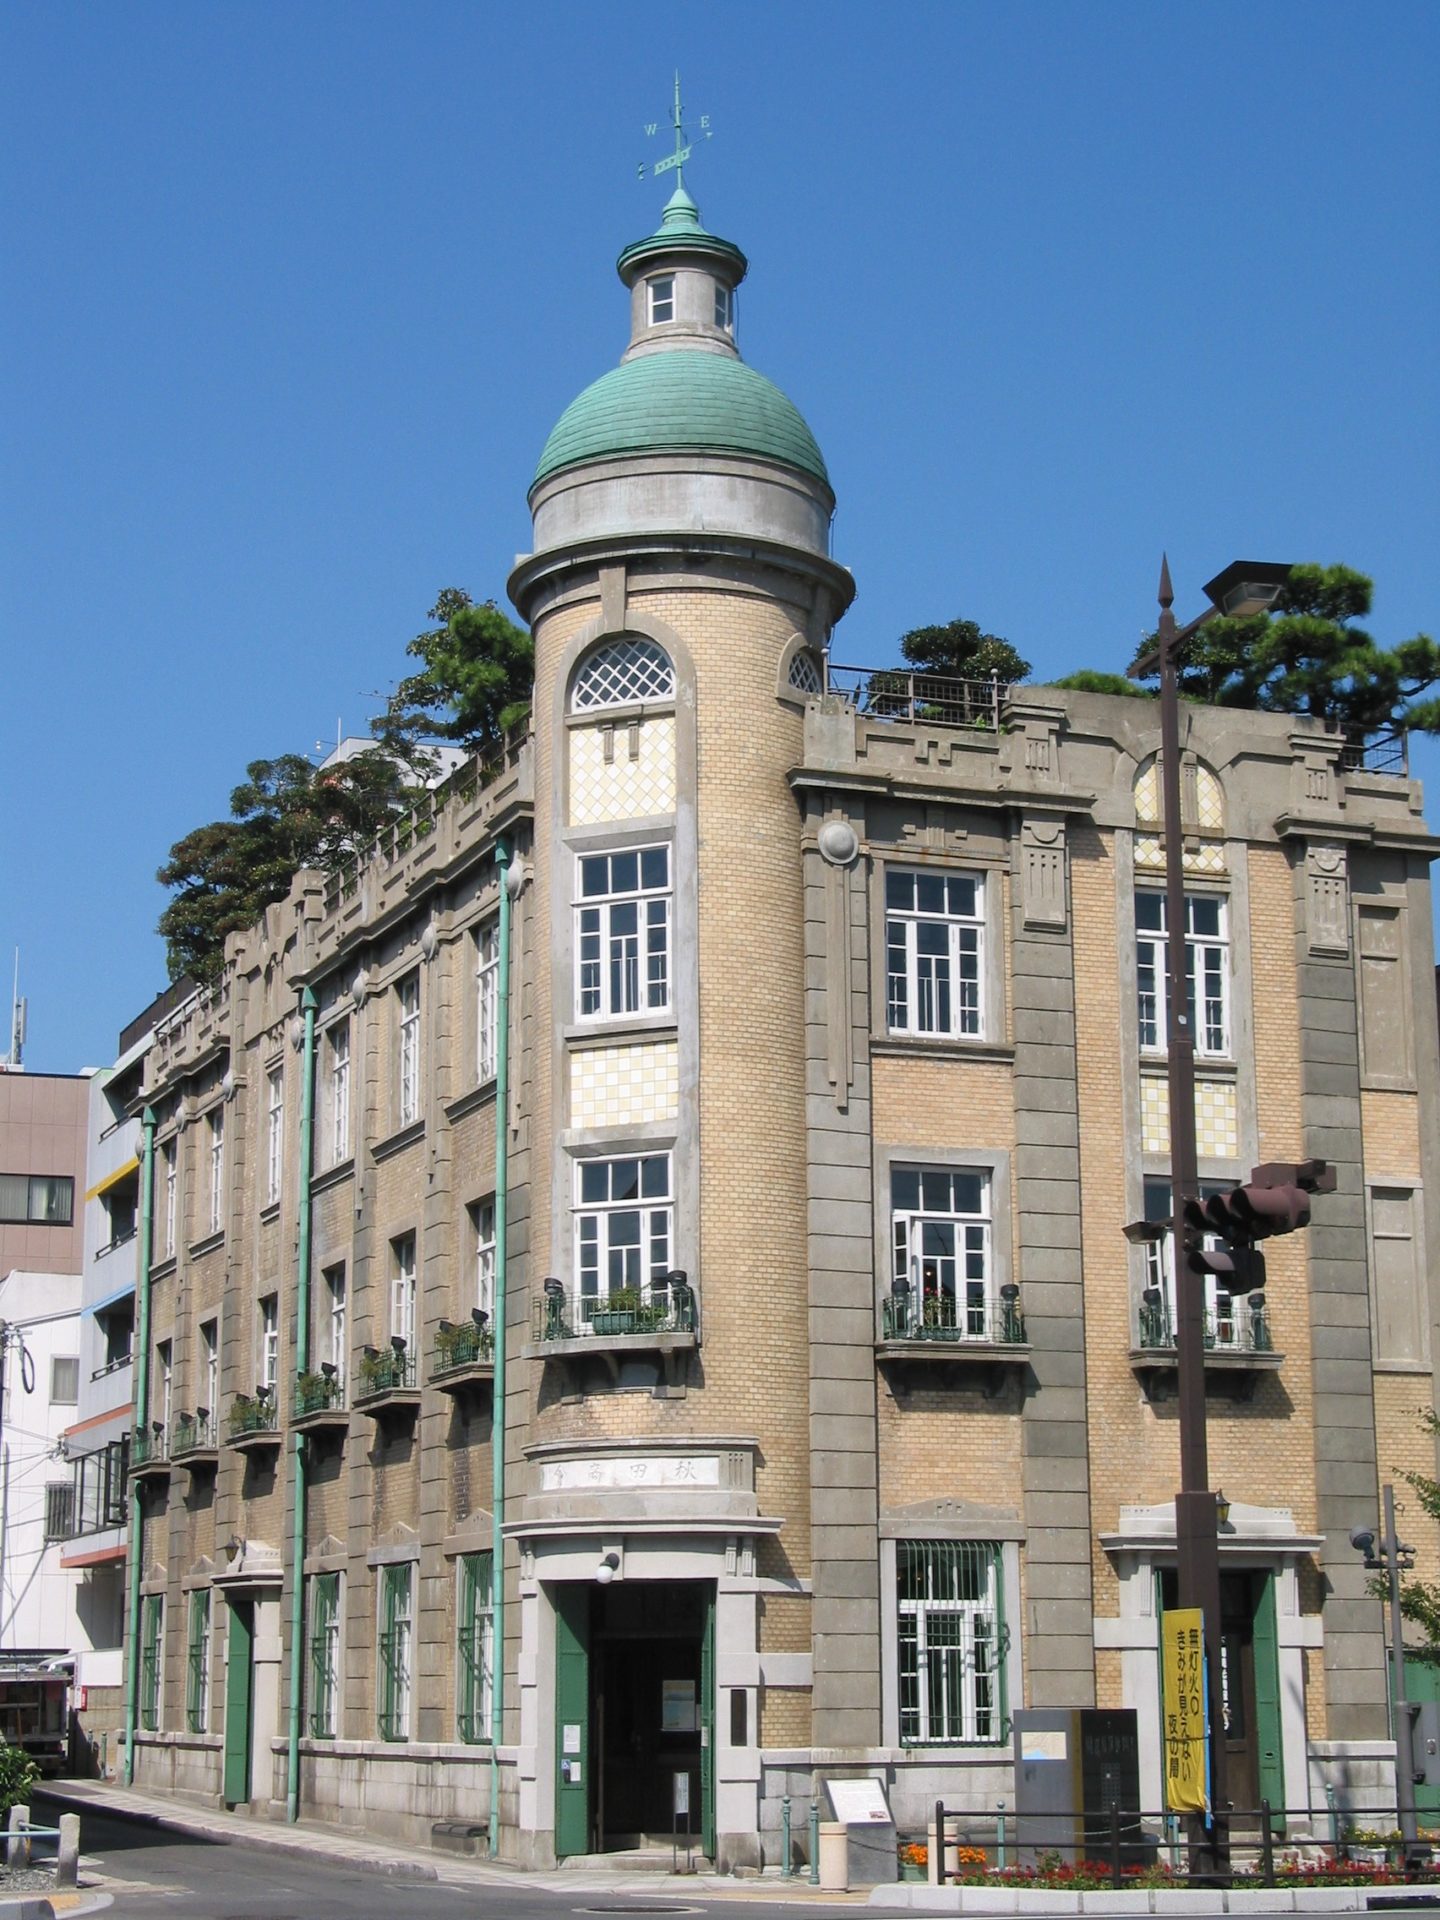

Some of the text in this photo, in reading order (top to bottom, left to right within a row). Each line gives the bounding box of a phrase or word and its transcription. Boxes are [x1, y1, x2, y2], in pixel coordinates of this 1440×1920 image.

[644, 123, 657, 137] W
[700, 115, 710, 129] E
[1188, 1628, 1200, 1717] 無灯火の
[1176, 1629, 1191, 1782] きみが見えない
